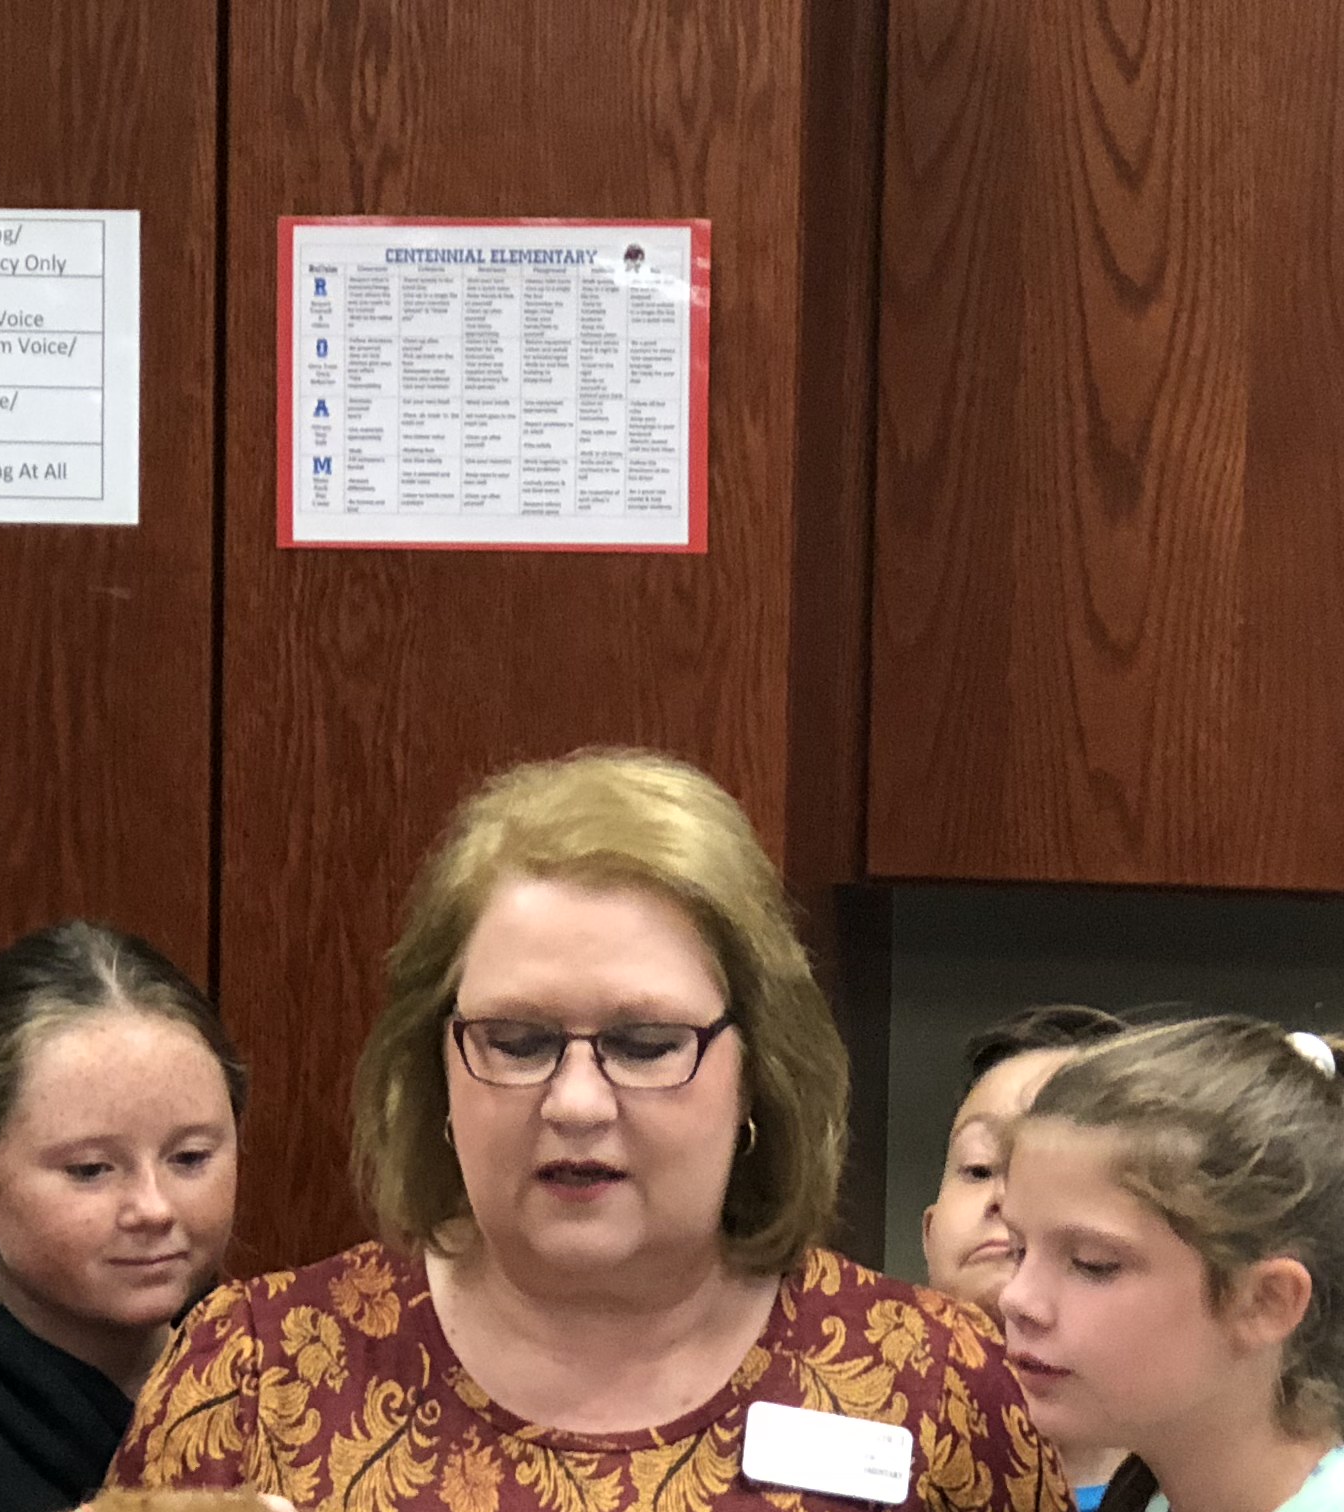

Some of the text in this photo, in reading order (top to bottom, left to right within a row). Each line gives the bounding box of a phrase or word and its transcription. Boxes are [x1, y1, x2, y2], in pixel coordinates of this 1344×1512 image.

[25, 254, 67, 275] Only
[385, 248, 597, 265] CENTENNIAL ELEMENTARY
[314, 277, 327, 297] R
[18, 336, 77, 357] Voice/
[313, 398, 330, 418] A
[19, 463, 38, 480] At
[44, 462, 67, 480] All
[313, 456, 332, 475] M
